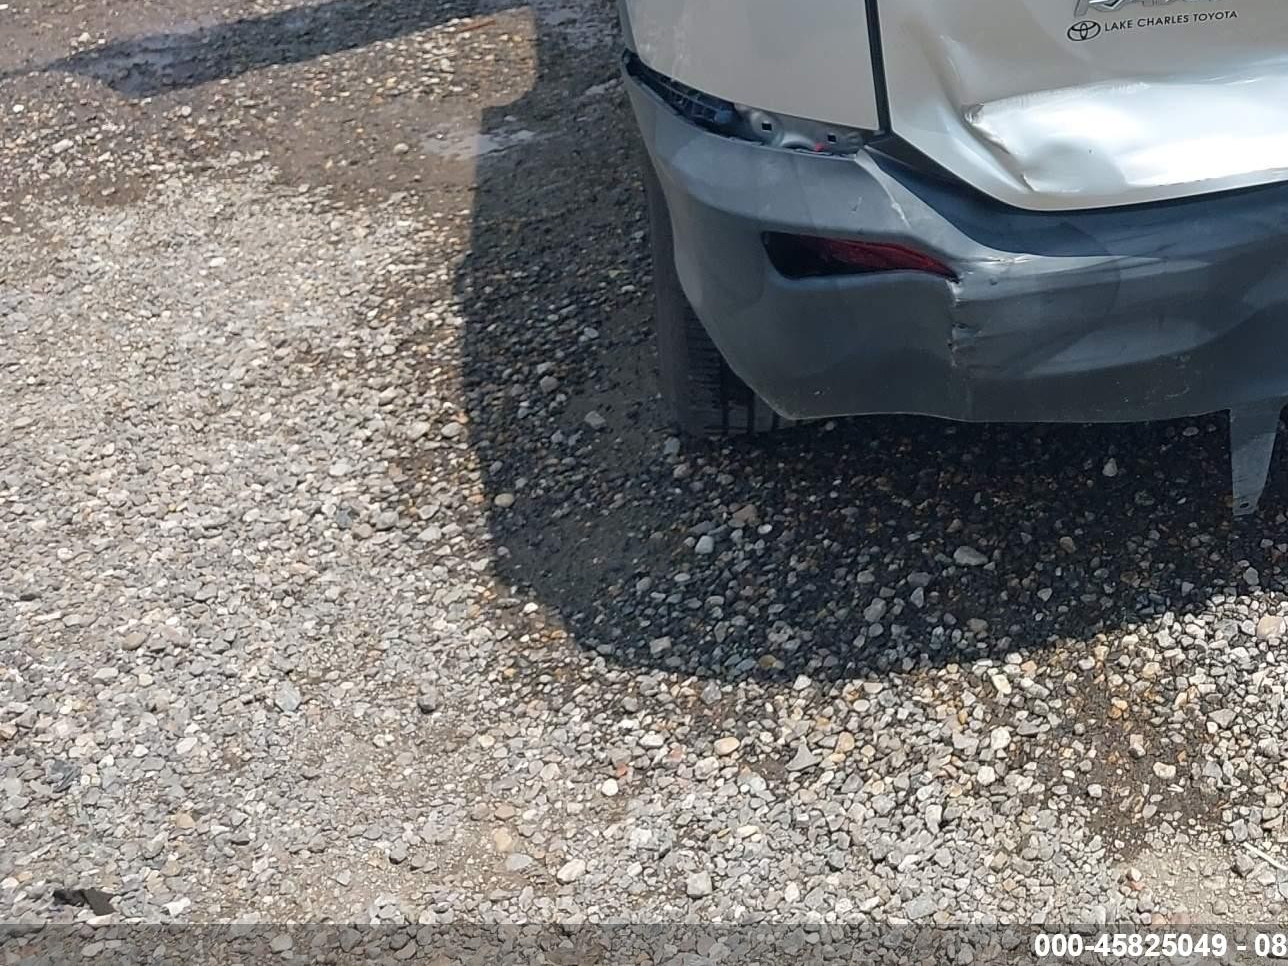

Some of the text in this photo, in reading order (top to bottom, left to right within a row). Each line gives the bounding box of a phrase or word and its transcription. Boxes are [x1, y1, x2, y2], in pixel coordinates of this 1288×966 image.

[1105, 10, 1238, 32] LAKE CHARLES TOYOTA
